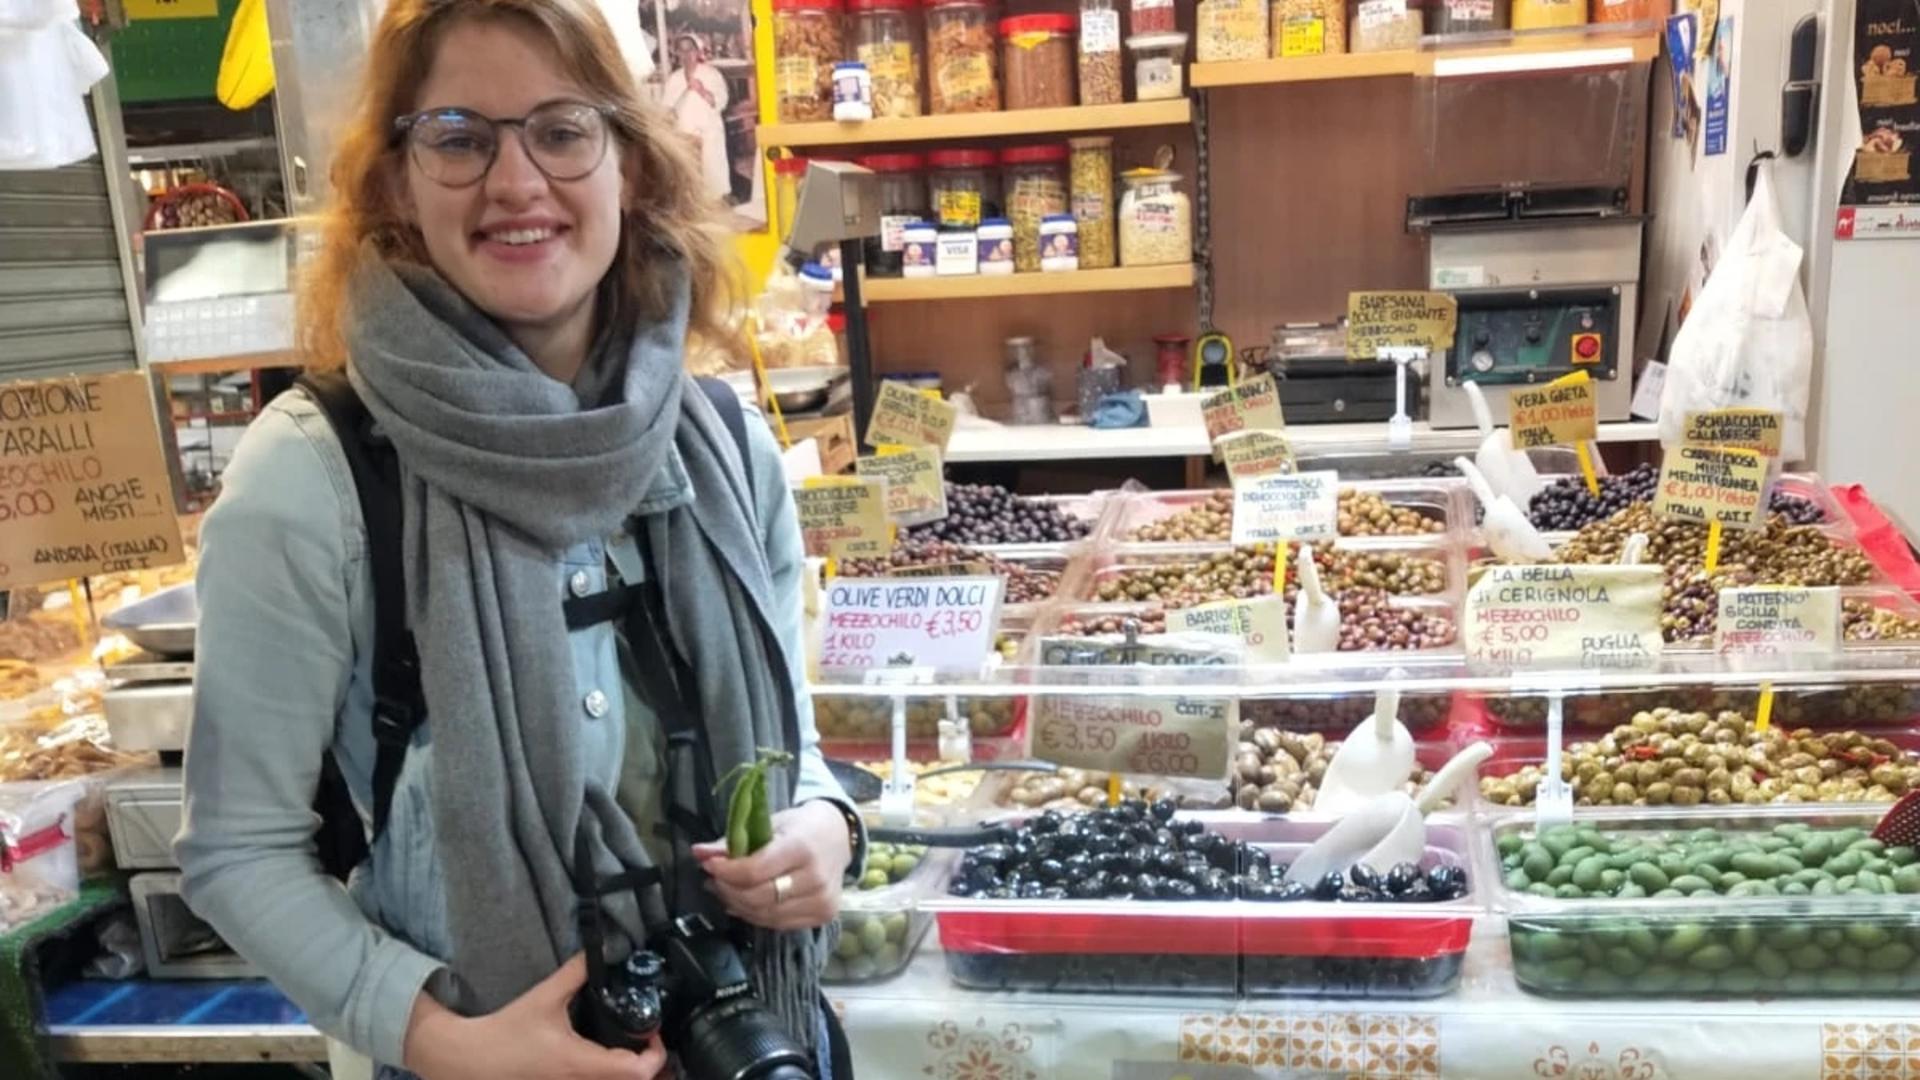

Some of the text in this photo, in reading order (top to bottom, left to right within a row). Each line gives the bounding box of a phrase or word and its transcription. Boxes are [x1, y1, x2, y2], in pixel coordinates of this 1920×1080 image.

[1391, 307, 1448, 321] GIGANTE
[0, 382, 102, 422] OZIONE
[1514, 385, 1589, 407] VERA GAETA
[1695, 414, 1777, 430] SCHIACCIATA
[74, 477, 145, 506] ANCHE
[1664, 482, 1714, 500] €1,00
[1665, 503, 1706, 519] ITALIA
[33, 535, 168, 564] ANDRIA (ITALIA)
[1493, 566, 1575, 583] LA BELLA
[831, 584, 987, 608] OLIVE VERDI DOLCI
[1499, 586, 1611, 604] CERIGNOLA
[1475, 607, 1581, 624] MEZZOCHILO
[1725, 606, 1779, 618] SICILIA
[829, 609, 984, 639] MEZZOCHILO €3,50
[1735, 618, 1803, 631] CONDITA
[841, 632, 876, 650] KILO
[1581, 633, 1642, 650] PUGLIA
[1489, 648, 1532, 666] KILO
[1041, 699, 1163, 728] MEZZOCHILO
[1041, 719, 1118, 753] €3,50
[1129, 752, 1201, 775] €6,00
[716, 982, 749, 998] Nikon
